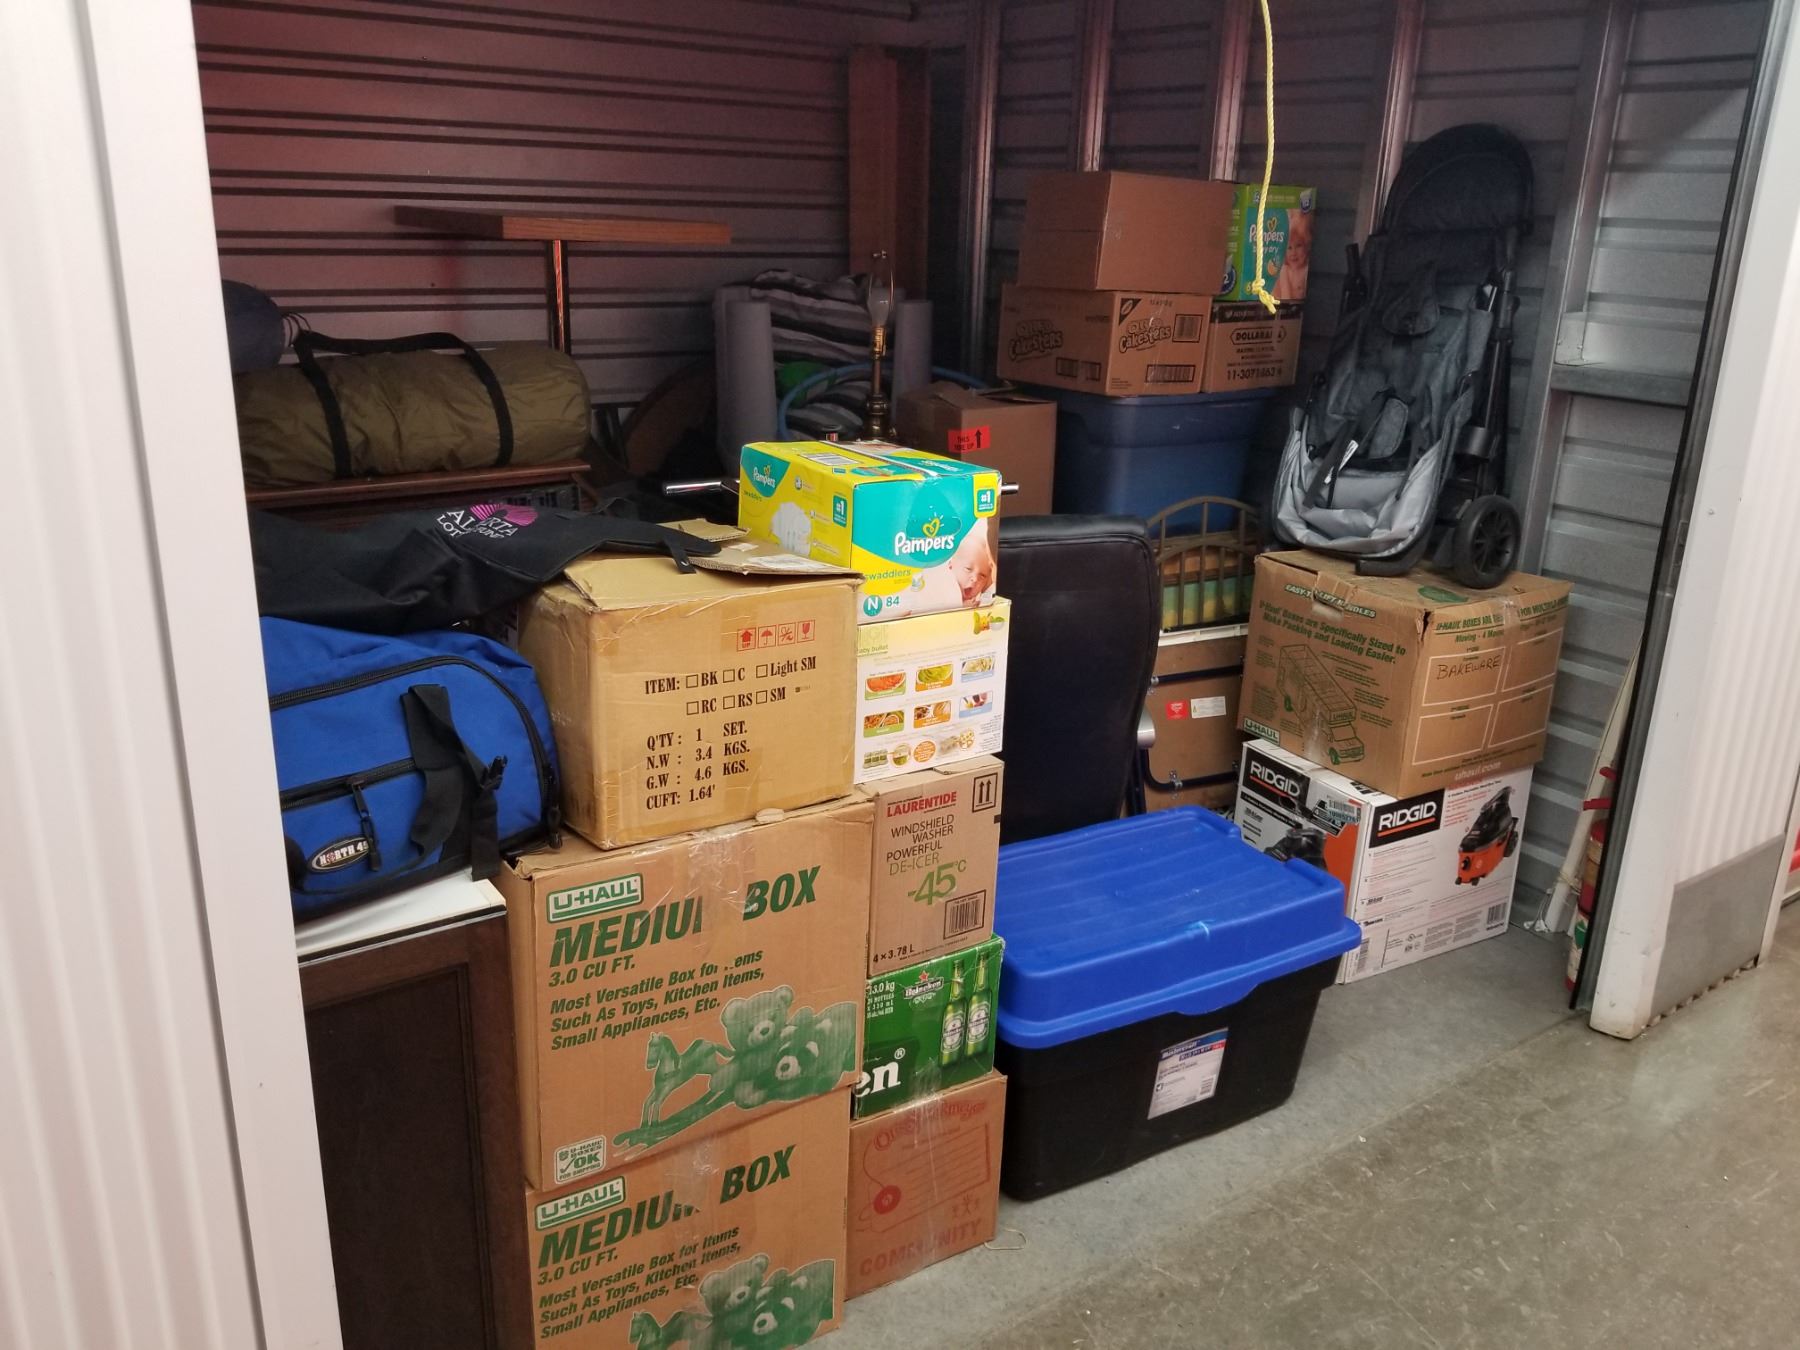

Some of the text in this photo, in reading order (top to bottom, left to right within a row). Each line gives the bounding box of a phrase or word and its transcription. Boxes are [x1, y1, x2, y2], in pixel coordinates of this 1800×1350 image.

[1249, 223, 1285, 245] Ppers
[1236, 330, 1281, 340] DOLLARAA
[753, 466, 776, 489] Pampers
[980, 490, 991, 503] #1
[894, 531, 955, 556] Pampers
[867, 596, 900, 611] N 84
[1282, 618, 1312, 639] Packing
[1314, 631, 1328, 642] and
[1331, 636, 1364, 656] Loading
[1365, 648, 1397, 664] Easier.
[1319, 622, 1368, 645] Specifically
[1369, 637, 1394, 653] Sized
[1396, 644, 1406, 656] to
[645, 656, 816, 694] ITEM: BK C Light SM
[1437, 655, 1501, 680] BAKEWARE
[702, 687, 786, 714] RC RS SM
[696, 728, 702, 742] 1
[723, 720, 748, 737] SET.
[1245, 719, 1278, 739] U-HAUL
[695, 746, 713, 762] 3.4
[724, 740, 750, 757] KGS.
[695, 766, 712, 782] 4.6
[723, 759, 749, 776] KGS.
[1250, 761, 1300, 797] RIDGID
[646, 791, 681, 810] CUFT:
[887, 791, 957, 818] LAURENTIDE
[891, 814, 954, 838] WINDSHIELD
[1379, 801, 1437, 831] RIDGID
[912, 824, 954, 845] WASHER
[319, 845, 356, 865] NORTH
[886, 842, 943, 862] POWERFUL
[889, 852, 940, 876] DE-ICER
[553, 878, 638, 912] U-HAUL
[550, 866, 821, 968] MEDIU BOX
[888, 946, 907, 959] 3.78
[549, 955, 635, 987] 3.0 CU FT.
[550, 996, 592, 1015] Most
[596, 976, 664, 1004] Versatile
[668, 970, 696, 986] Box
[724, 950, 763, 971] ems
[885, 981, 895, 992] kg
[905, 980, 941, 997] Heineken
[551, 966, 765, 1033] Such As Toys, Kitchen Items,
[551, 996, 721, 1051] Small Appliances, Etc.
[574, 1152, 601, 1168] OK
[720, 1144, 796, 1203] BOX
[540, 1183, 620, 1220] U-HAUL
[859, 1218, 982, 1276] COMMNITY
[537, 1248, 618, 1286] 3.0 CU FT.
[539, 1227, 739, 1308] Most Versatile Box for Items
[540, 1242, 741, 1324] Such As Toys, Kitchen Items,
[540, 1273, 699, 1339] Small Appliances, Etc.
